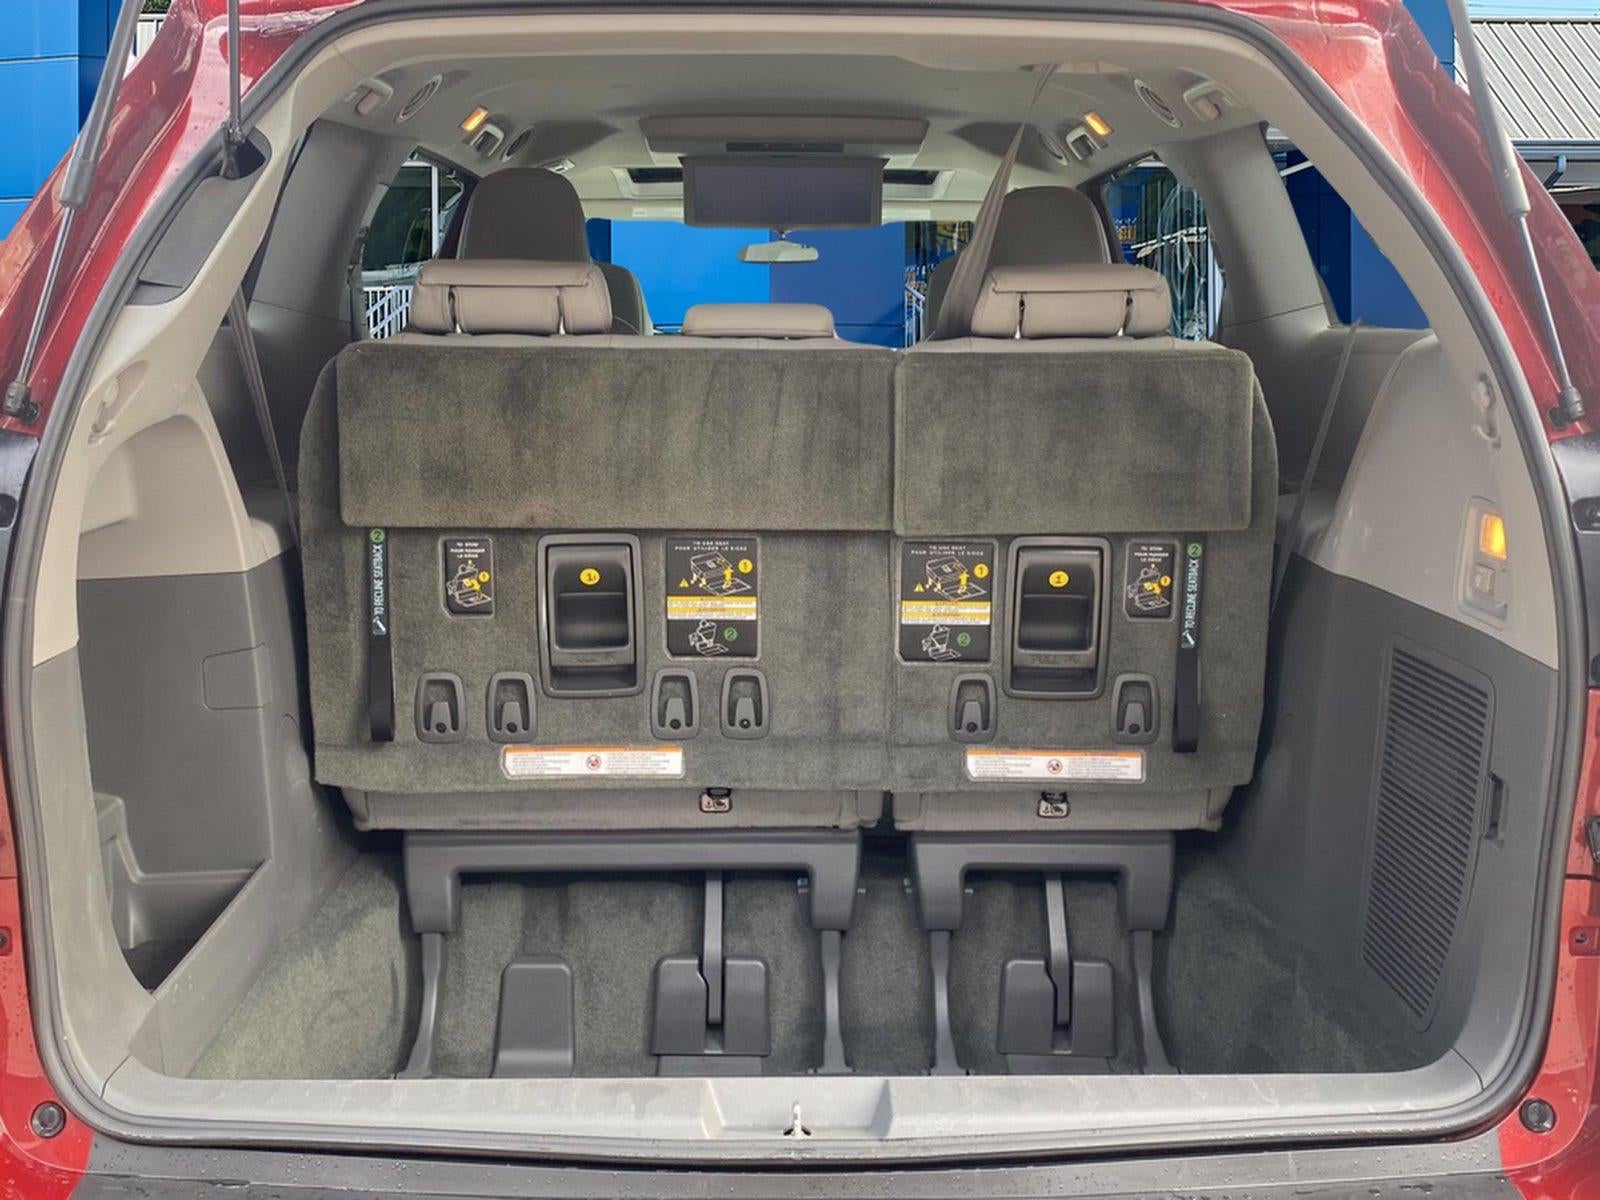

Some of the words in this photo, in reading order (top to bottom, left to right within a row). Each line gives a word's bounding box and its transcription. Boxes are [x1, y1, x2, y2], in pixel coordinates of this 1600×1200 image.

[372, 544, 383, 578] SEATBACK
[1187, 559, 1199, 592] SEATBACK
[373, 579, 384, 607] RECLINE
[1185, 593, 1197, 619] RECLINE
[374, 607, 384, 616] TO
[1185, 620, 1196, 629] TO
